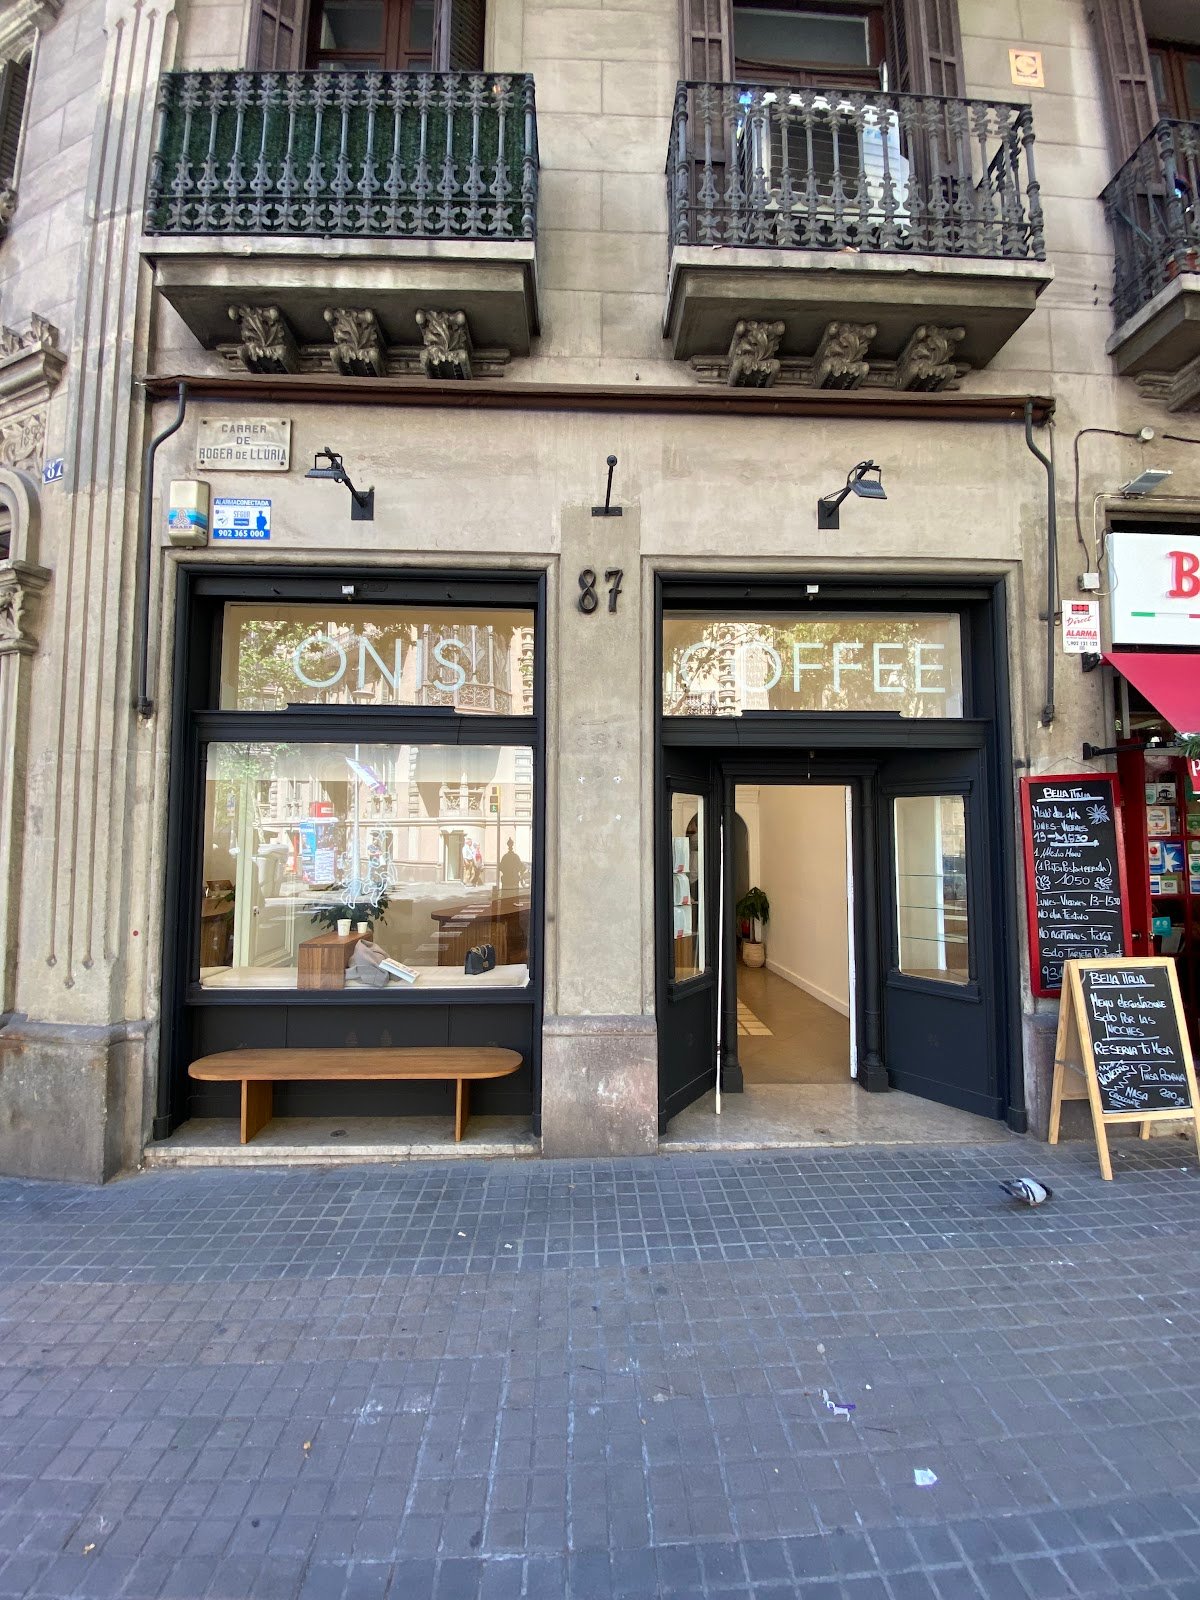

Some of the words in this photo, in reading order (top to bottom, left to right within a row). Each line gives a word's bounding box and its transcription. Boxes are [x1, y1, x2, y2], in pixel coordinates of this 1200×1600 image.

[221, 424, 267, 433] CARRER
[236, 436, 250, 445] DE
[199, 447, 233, 460] ROGER
[235, 451, 248, 460] DE
[47, 458, 64, 478] 87
[578, 567, 624, 615] 87
[1066, 629, 1098, 637] ALARMA
[292, 635, 466, 691] ONIS
[680, 642, 946, 693] COFFEE
[1089, 972, 1120, 984] BELLA
[1117, 971, 1146, 984] ITALIA
[1107, 1024, 1144, 1036] NOCHES
[1094, 1041, 1138, 1055] RESERVA
